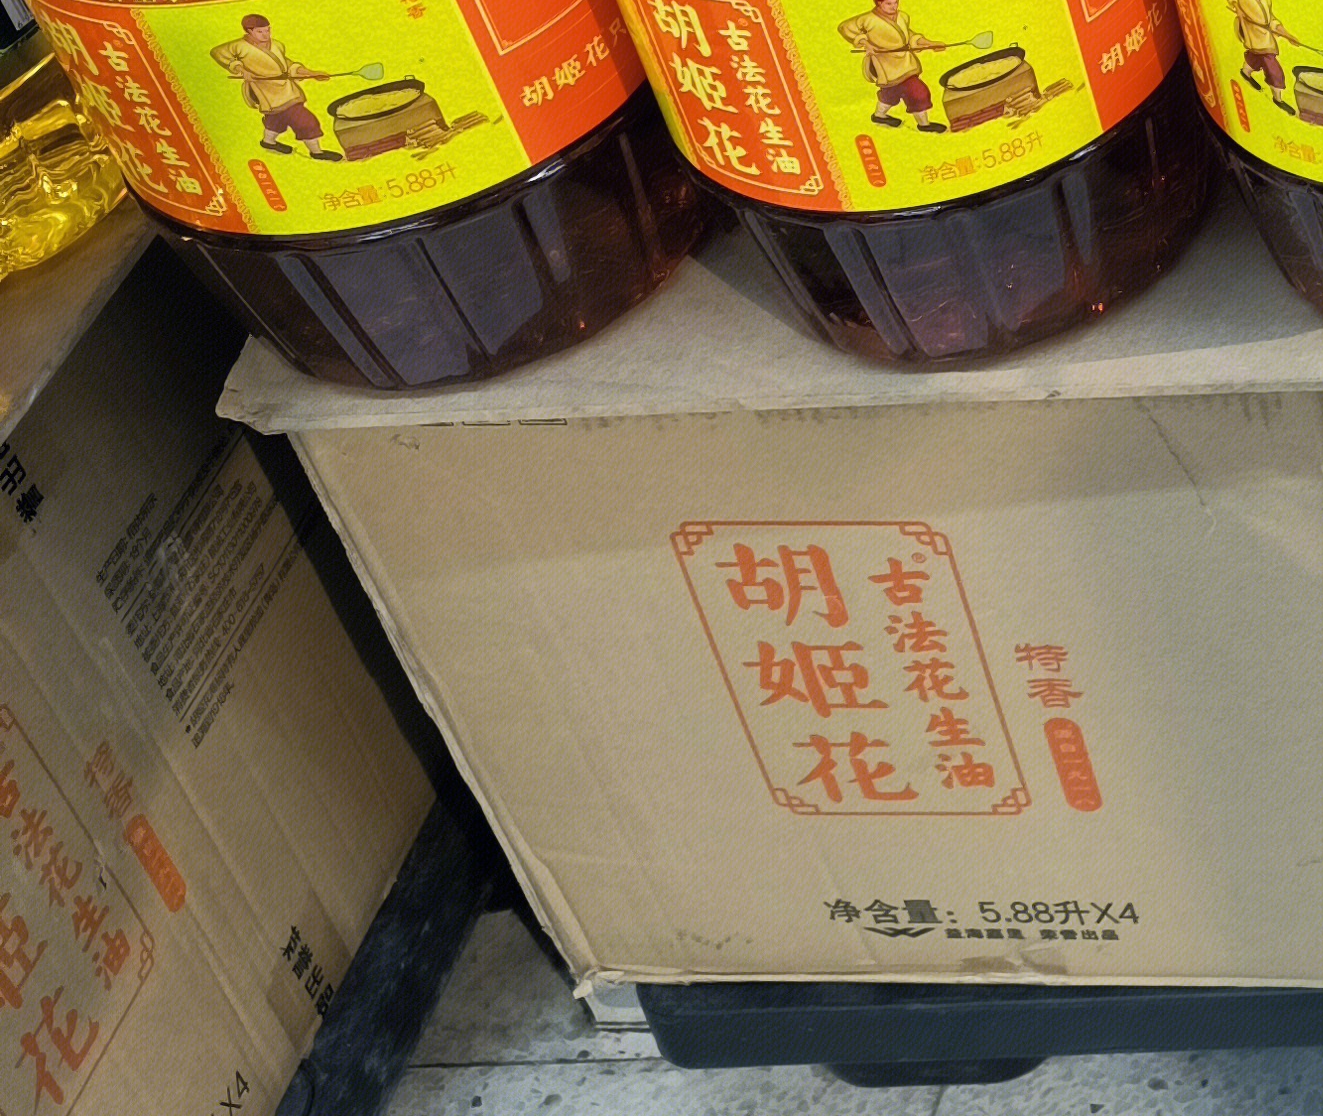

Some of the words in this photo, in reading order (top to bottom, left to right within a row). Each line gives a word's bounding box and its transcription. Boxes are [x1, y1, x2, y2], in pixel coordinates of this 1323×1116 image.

[97, 38, 204, 198] 古法花生油
[716, 17, 803, 178] 古法花生油
[714, 543, 920, 804] 胡姬花
[867, 556, 997, 791] 古法花生油
[1014, 643, 1085, 709] 特香
